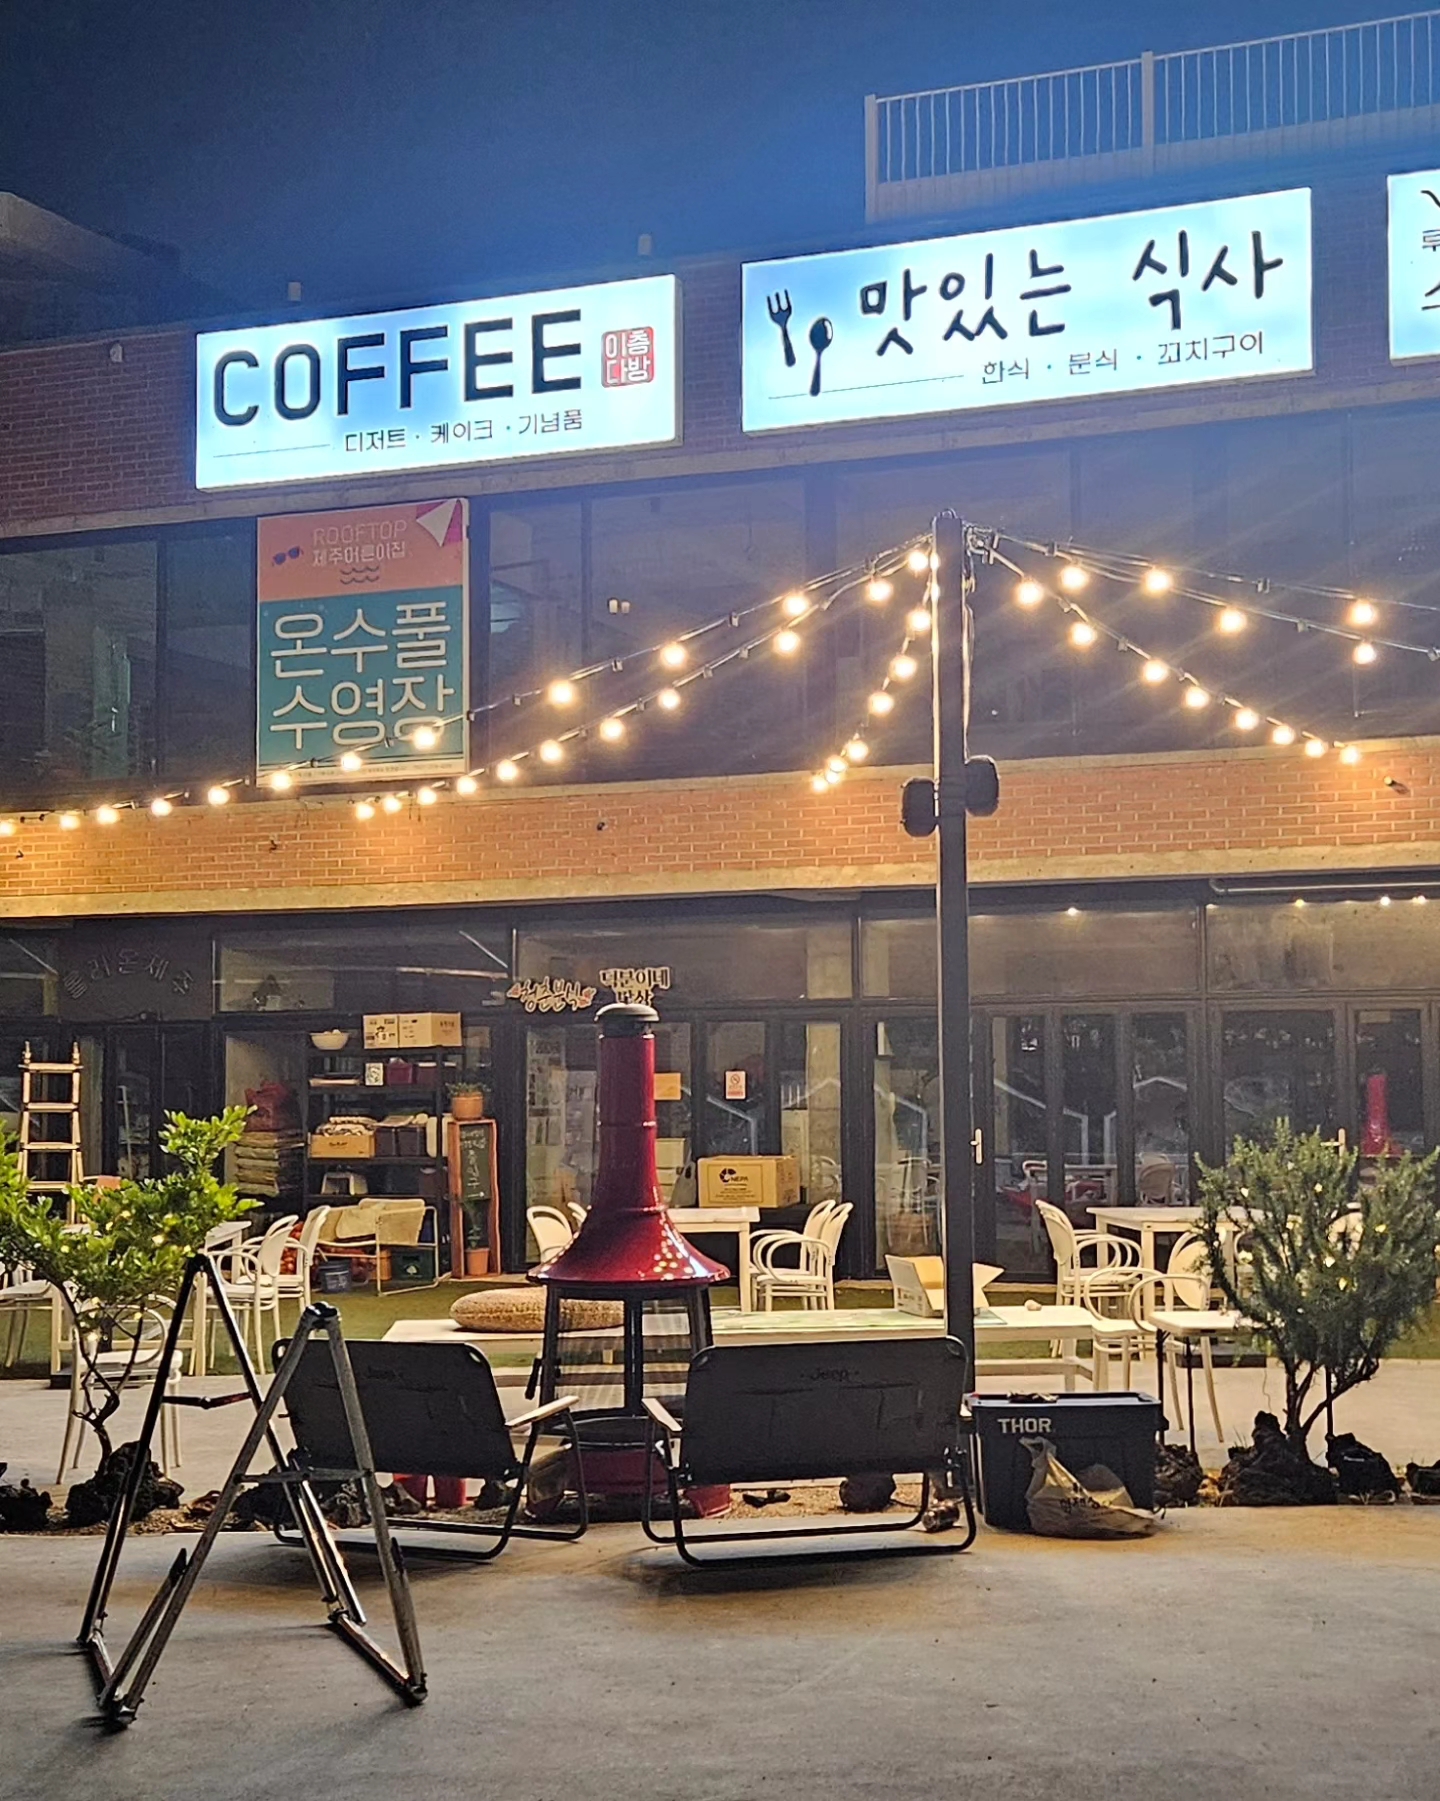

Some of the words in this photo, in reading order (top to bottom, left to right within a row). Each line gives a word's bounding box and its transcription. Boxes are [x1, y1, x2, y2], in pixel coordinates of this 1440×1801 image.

[858, 248, 1072, 358] 맛있는
[1132, 229, 1283, 330] 식사
[213, 308, 582, 426] COFFEE
[605, 355, 652, 385] 다방
[981, 357, 1030, 385] 한식
[1068, 348, 1118, 376] 분식
[1157, 330, 1264, 366] 꼬치구이
[344, 428, 407, 452] 디저트
[430, 419, 493, 445] 케이크
[518, 408, 583, 436] 기념품
[313, 519, 408, 546] ROOFTOP
[270, 601, 451, 678] 온수풀
[270, 674, 455, 750] 수영장
[997, 1417, 1052, 1434] THOR
